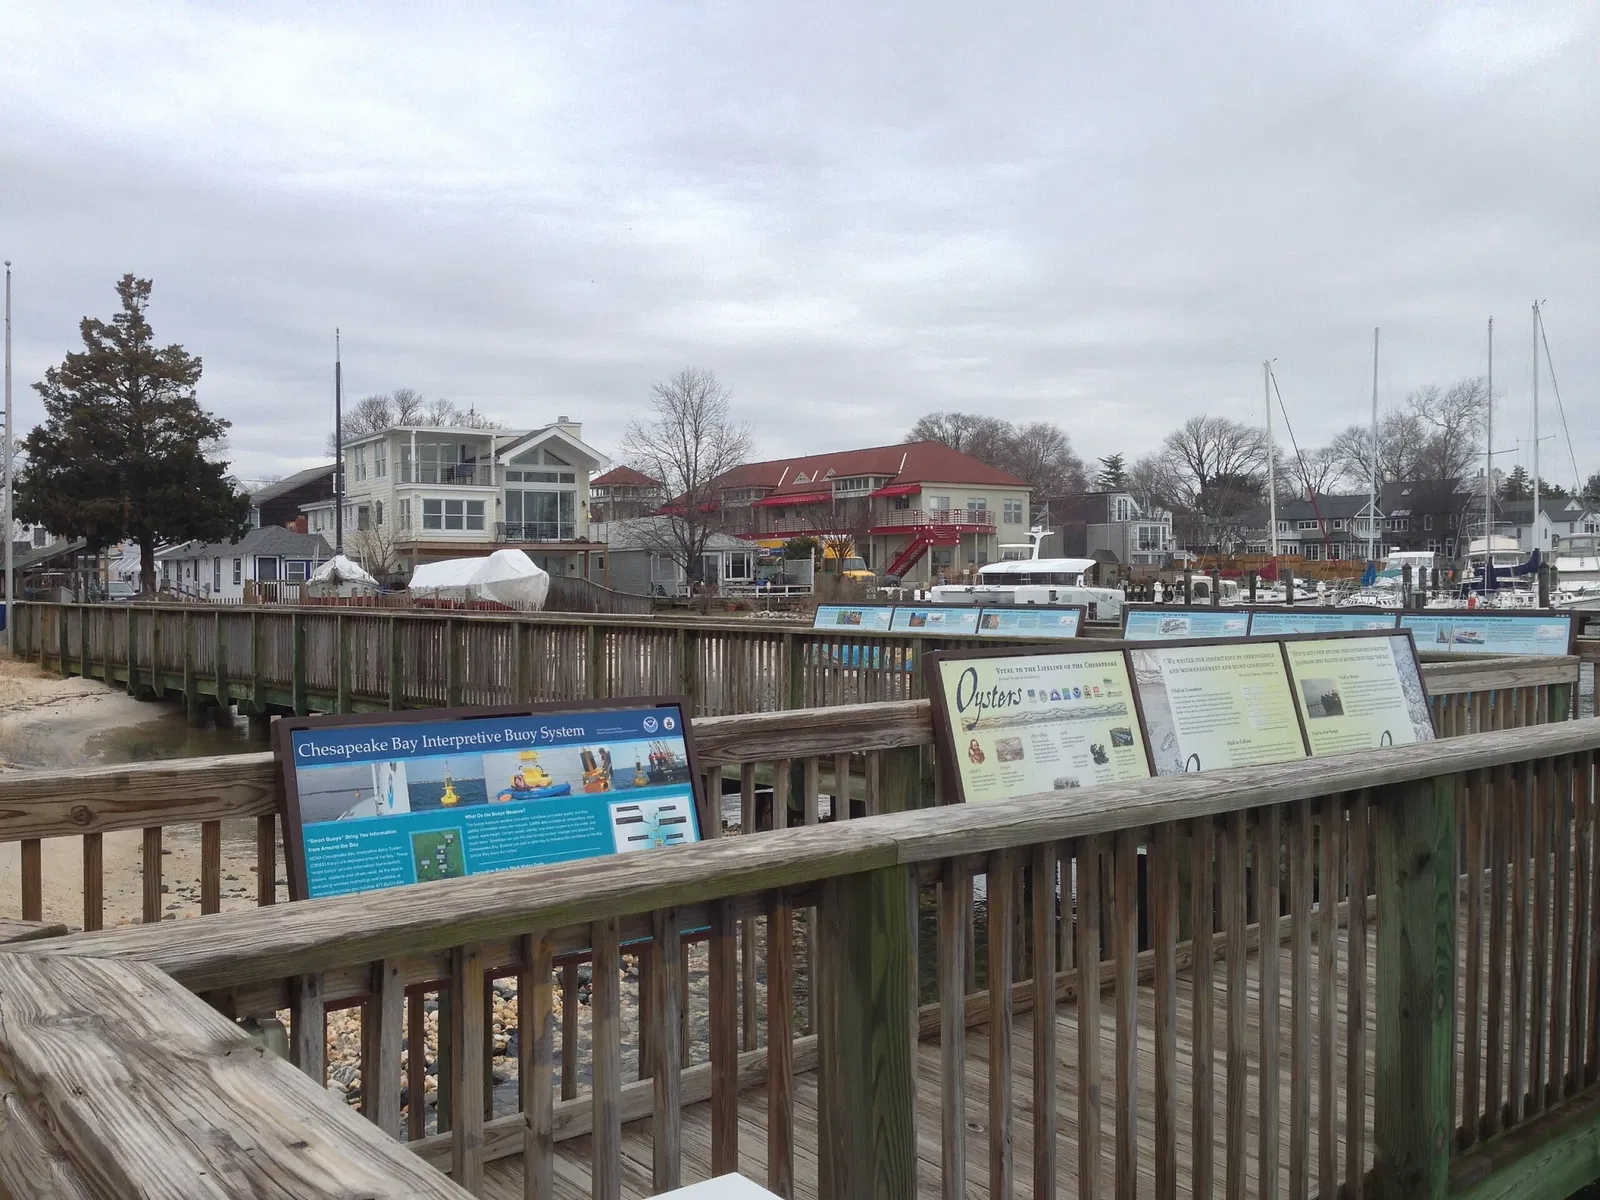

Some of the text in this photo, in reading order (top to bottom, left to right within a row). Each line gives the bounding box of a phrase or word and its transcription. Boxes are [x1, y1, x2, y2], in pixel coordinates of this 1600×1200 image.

[996, 667, 1014, 675] VITAL
[1037, 664, 1063, 672] LIFELINE
[957, 667, 1023, 731] Oysters
[299, 739, 388, 758] Chesapeake
[391, 737, 419, 753] Bay
[423, 731, 502, 750] Interpretive
[504, 729, 537, 743] Buoy
[541, 726, 585, 742] System
[506, 808, 526, 816] Measure?
